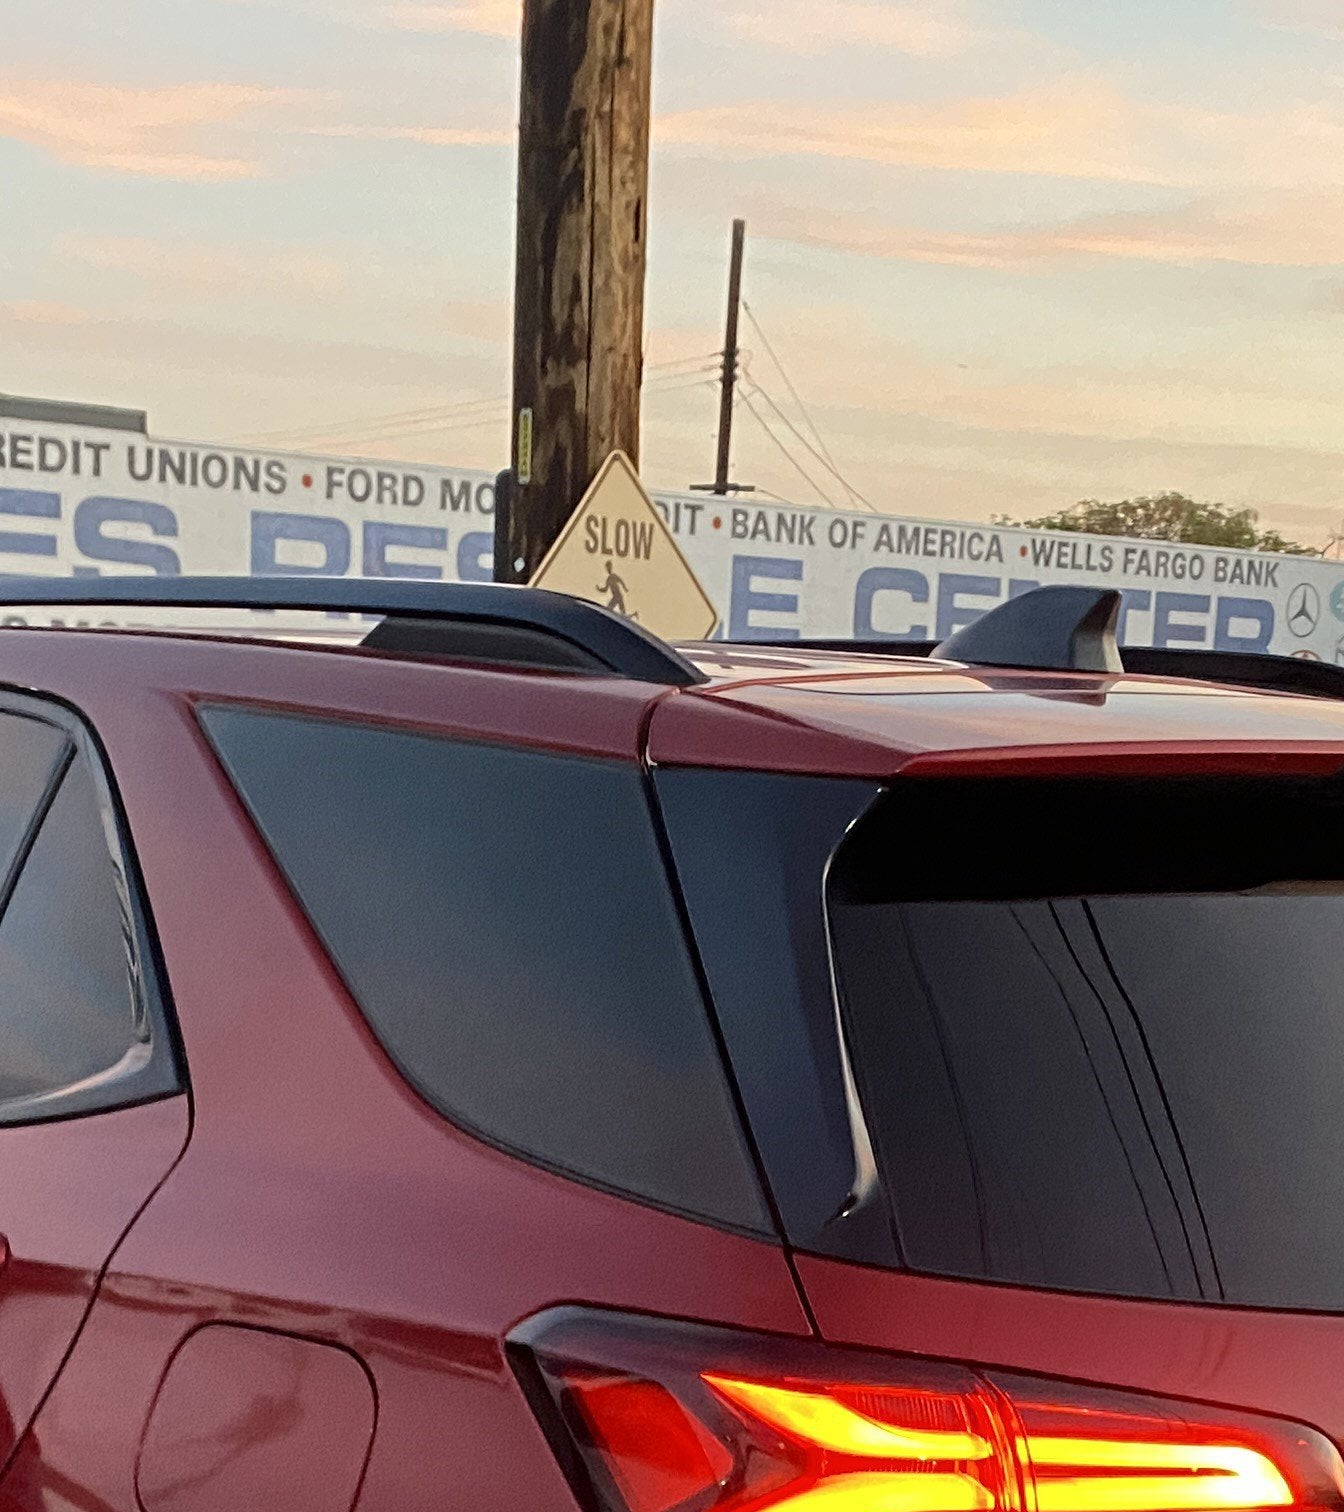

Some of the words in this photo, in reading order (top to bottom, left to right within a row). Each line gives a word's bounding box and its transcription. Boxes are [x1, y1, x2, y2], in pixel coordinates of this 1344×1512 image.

[127, 445, 288, 494] UNIONS
[326, 466, 426, 507] FORD
[585, 513, 655, 560] SLOW
[731, 508, 816, 546] BANK
[829, 518, 866, 550] OF
[874, 523, 1005, 564] AMERICA
[1031, 538, 1114, 573] WELLS
[1123, 547, 1205, 581] FARGO
[1214, 558, 1280, 588] BANK
